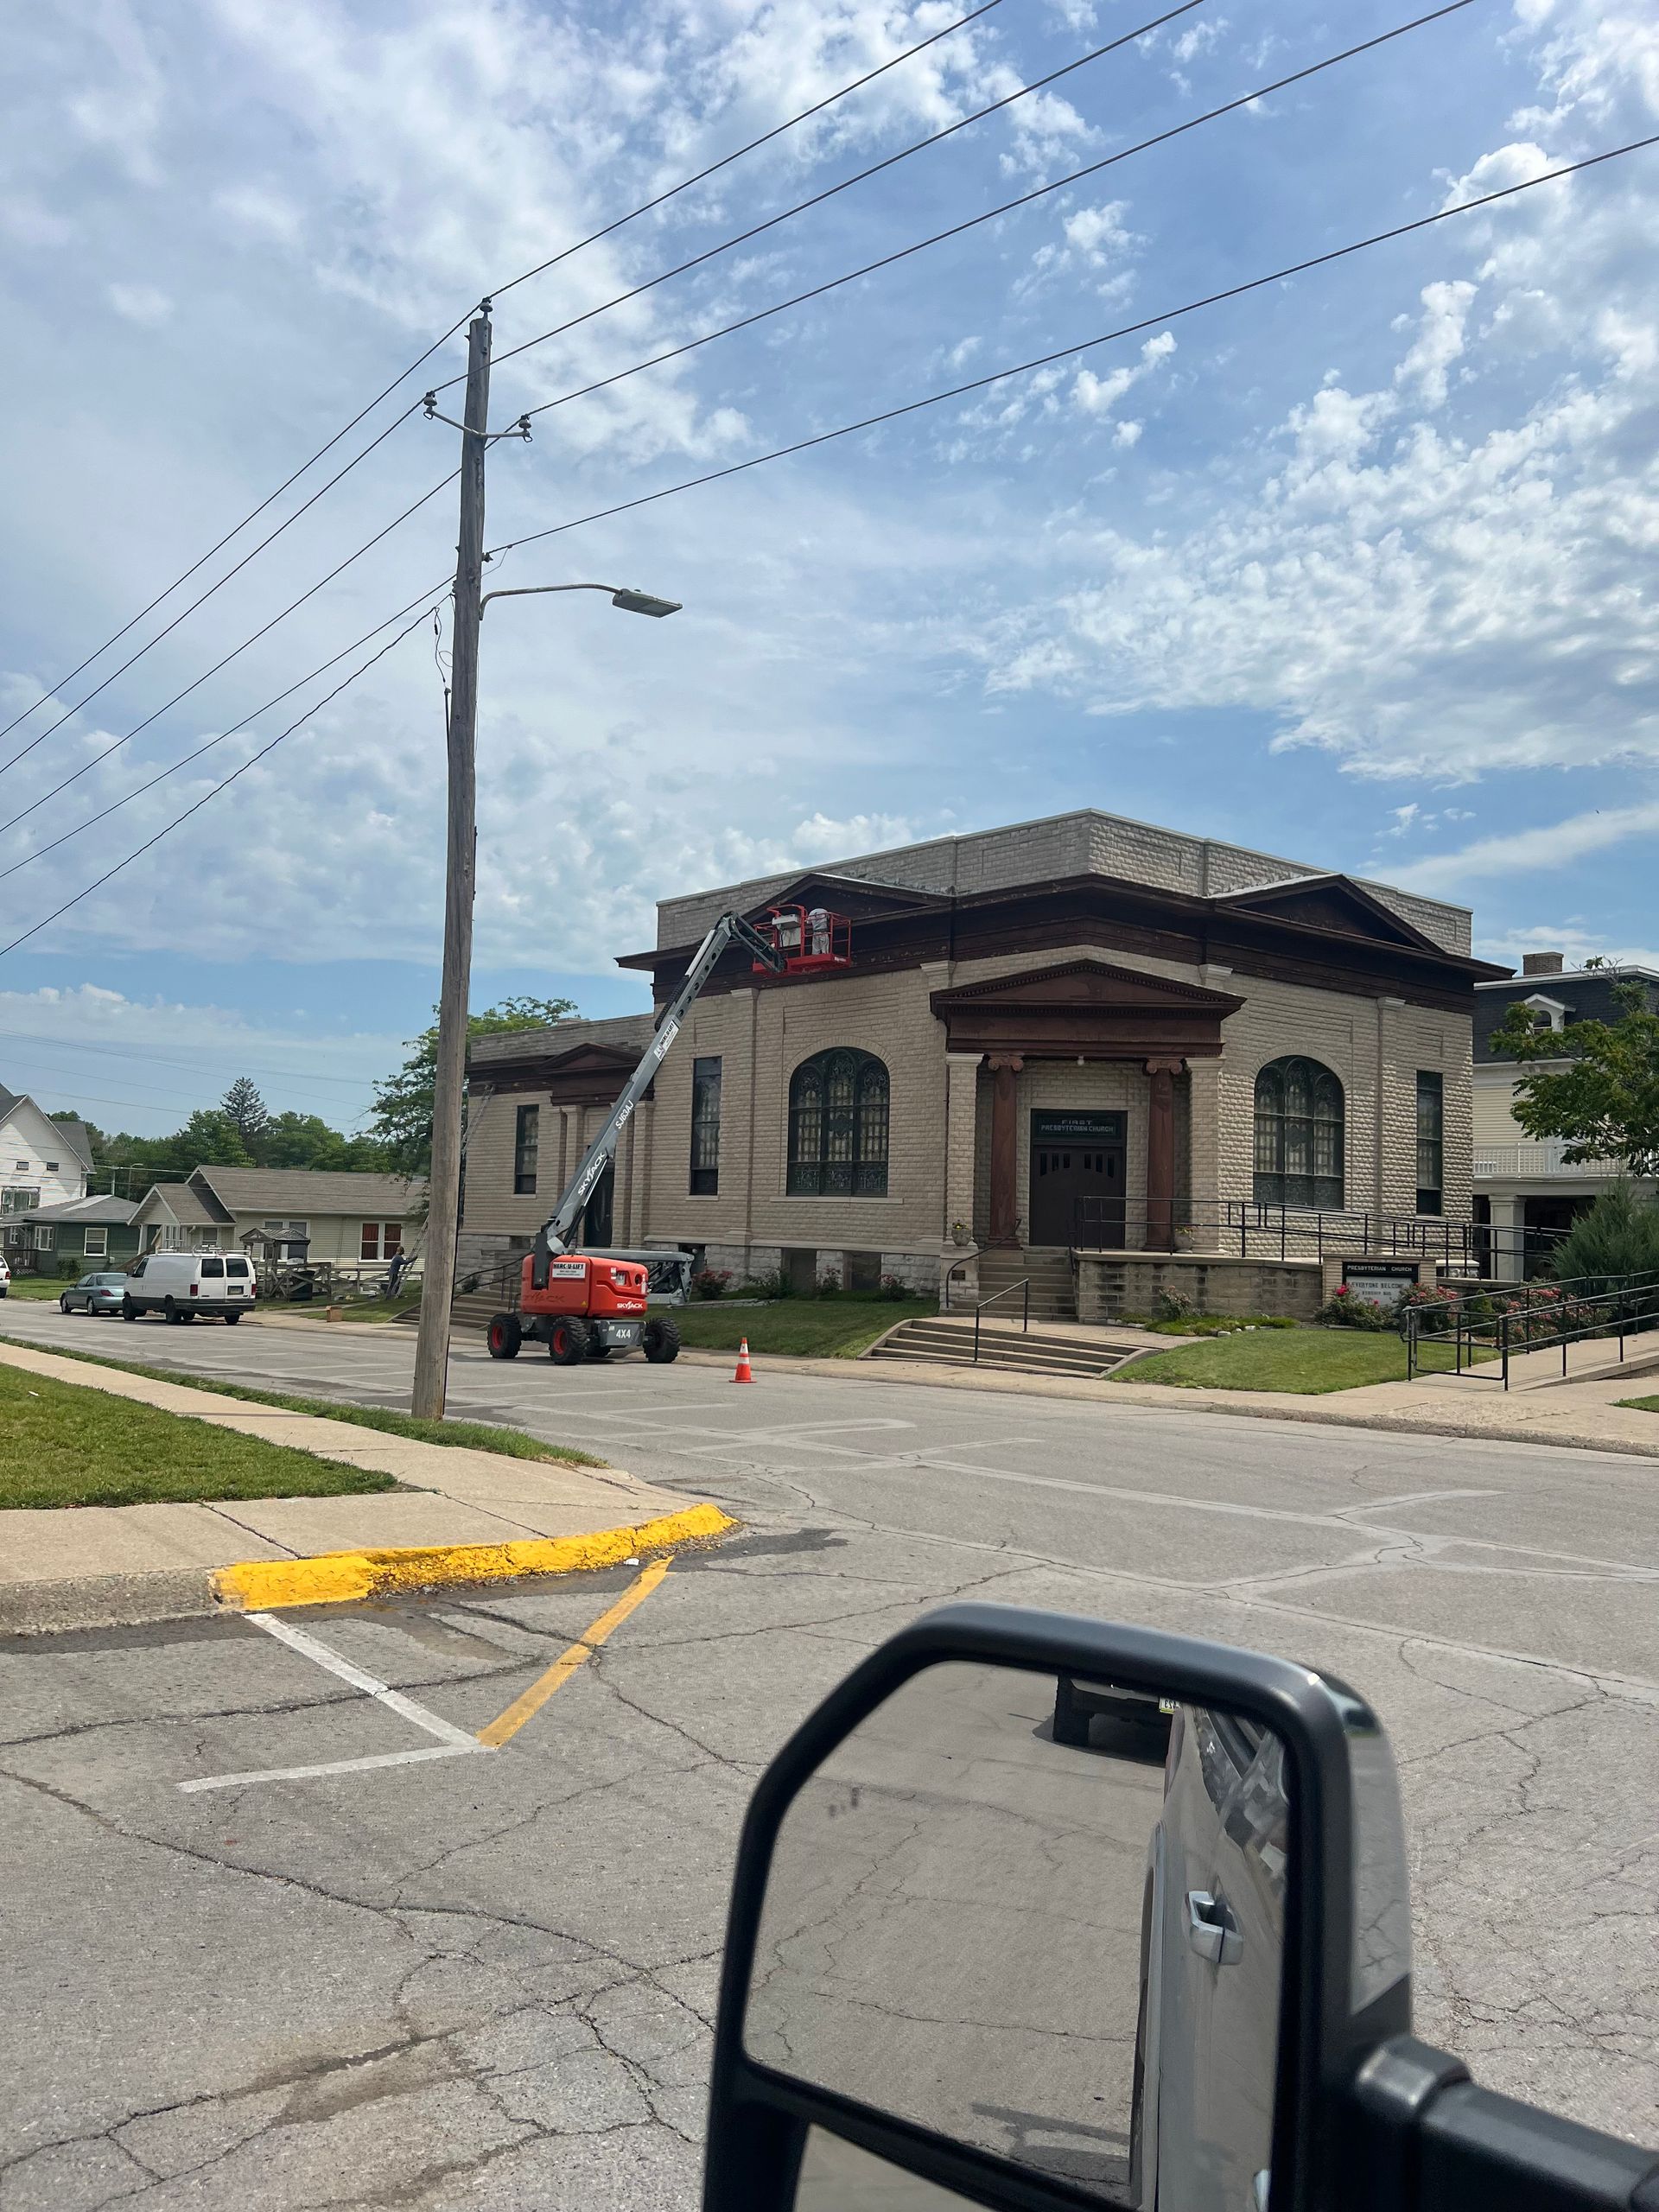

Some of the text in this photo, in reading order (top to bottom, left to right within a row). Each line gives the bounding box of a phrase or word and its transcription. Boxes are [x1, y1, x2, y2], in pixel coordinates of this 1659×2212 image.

[615, 1100, 634, 1128] SJ63AJ
[577, 1152, 606, 1196] SKYJACK
[617, 1301, 643, 1310] SKYJACK
[616, 1329, 631, 1338] 4X4
